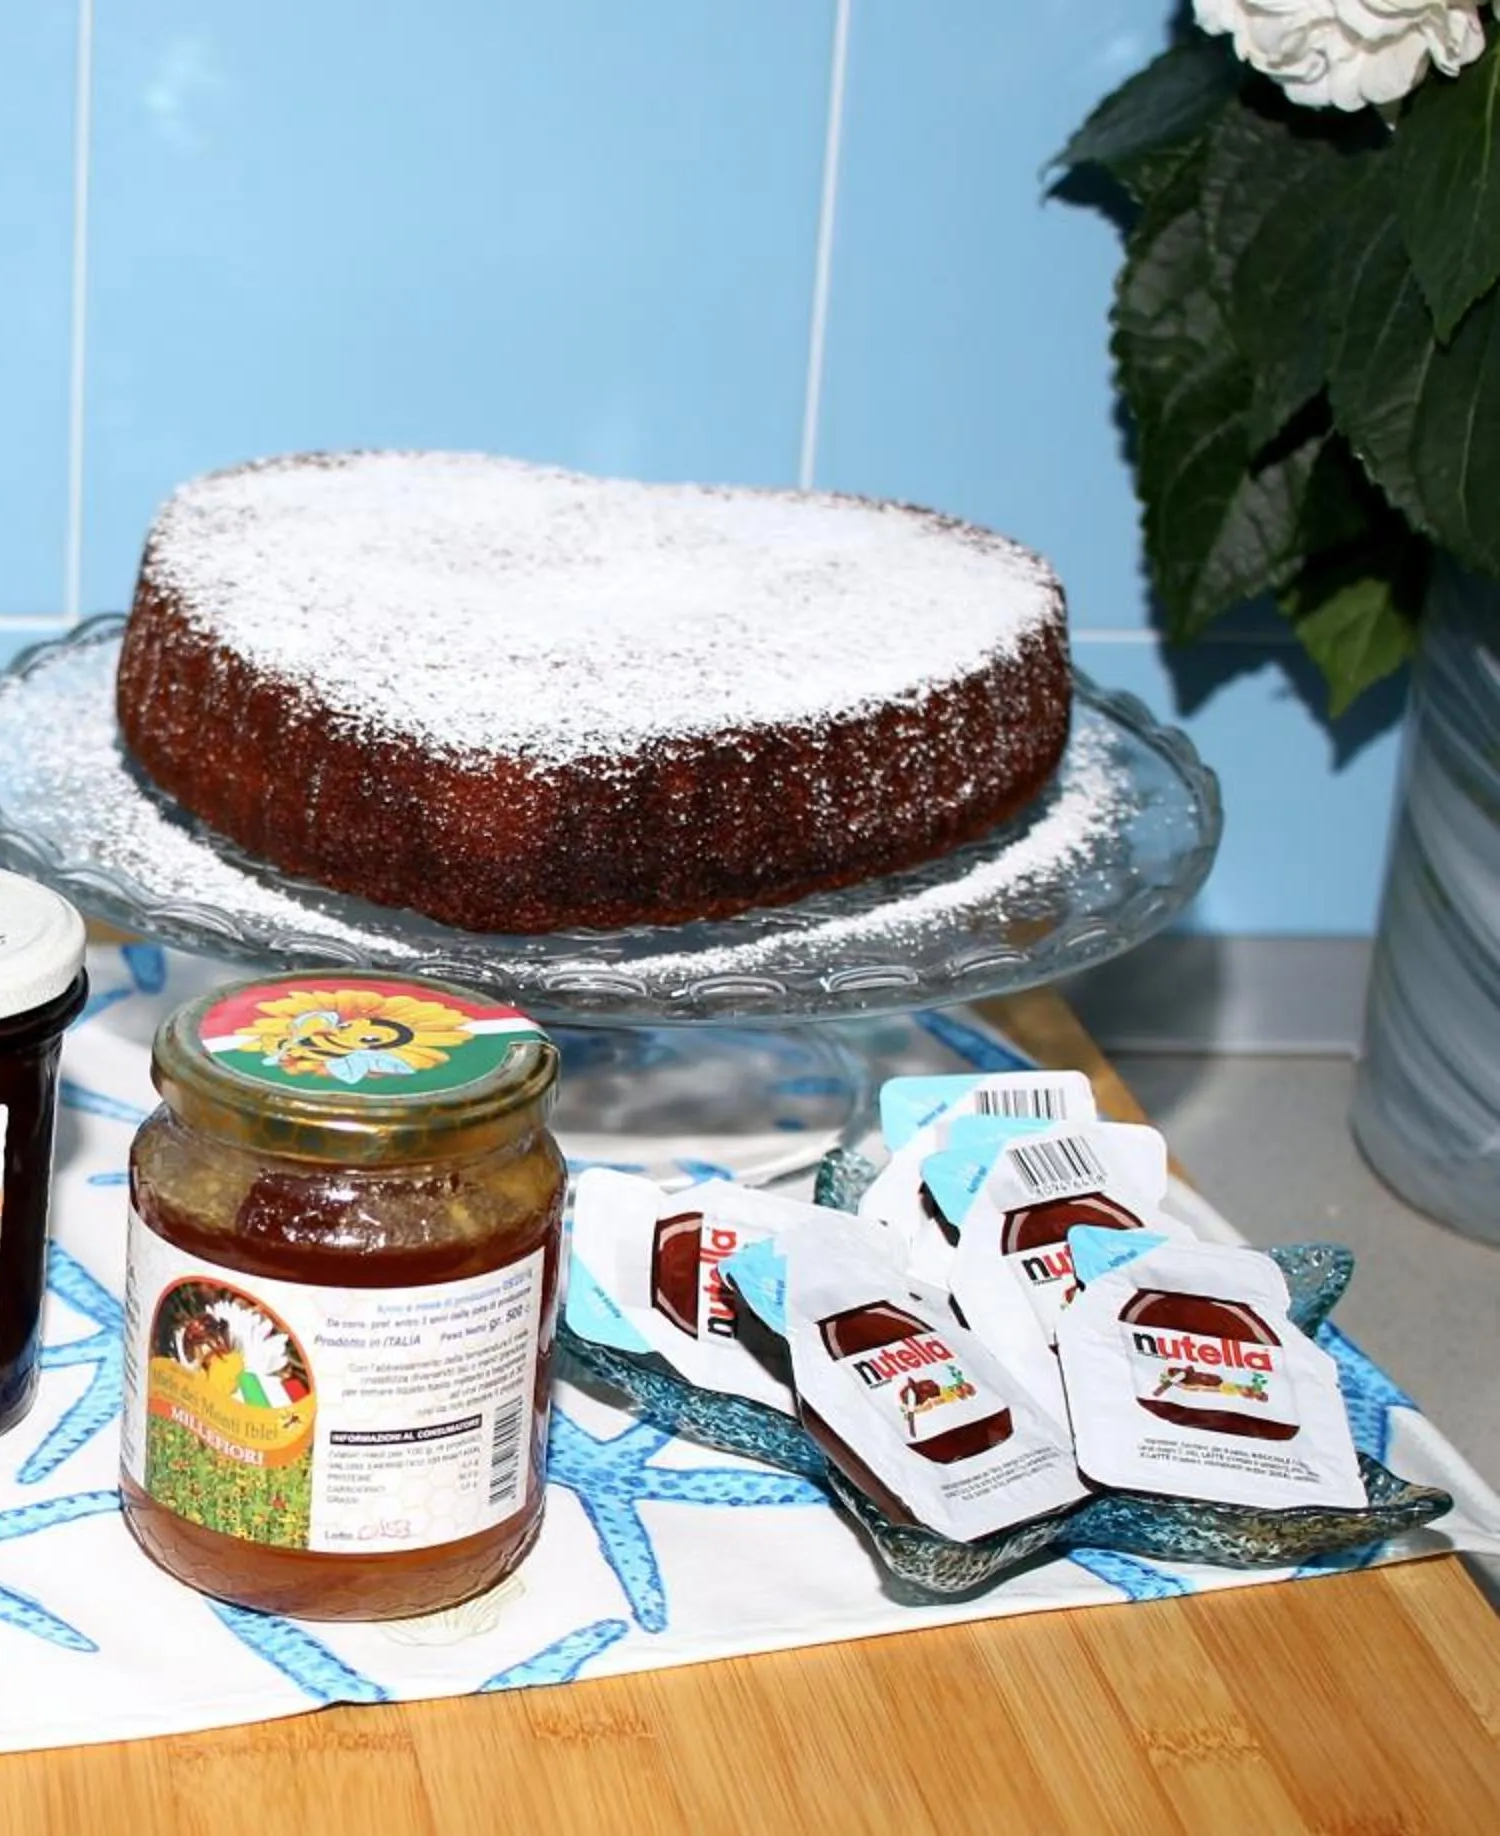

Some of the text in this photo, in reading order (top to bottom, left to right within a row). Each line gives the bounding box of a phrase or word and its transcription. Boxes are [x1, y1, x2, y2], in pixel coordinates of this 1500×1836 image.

[382, 1333, 421, 1348] ITALIA
[853, 1334, 955, 1385] nutella
[1133, 1332, 1273, 1373] nutella
[171, 1404, 264, 1466] MILLEFIORI
[332, 1417, 481, 1444] INFORMAZIONI AL CONSUMATORE
